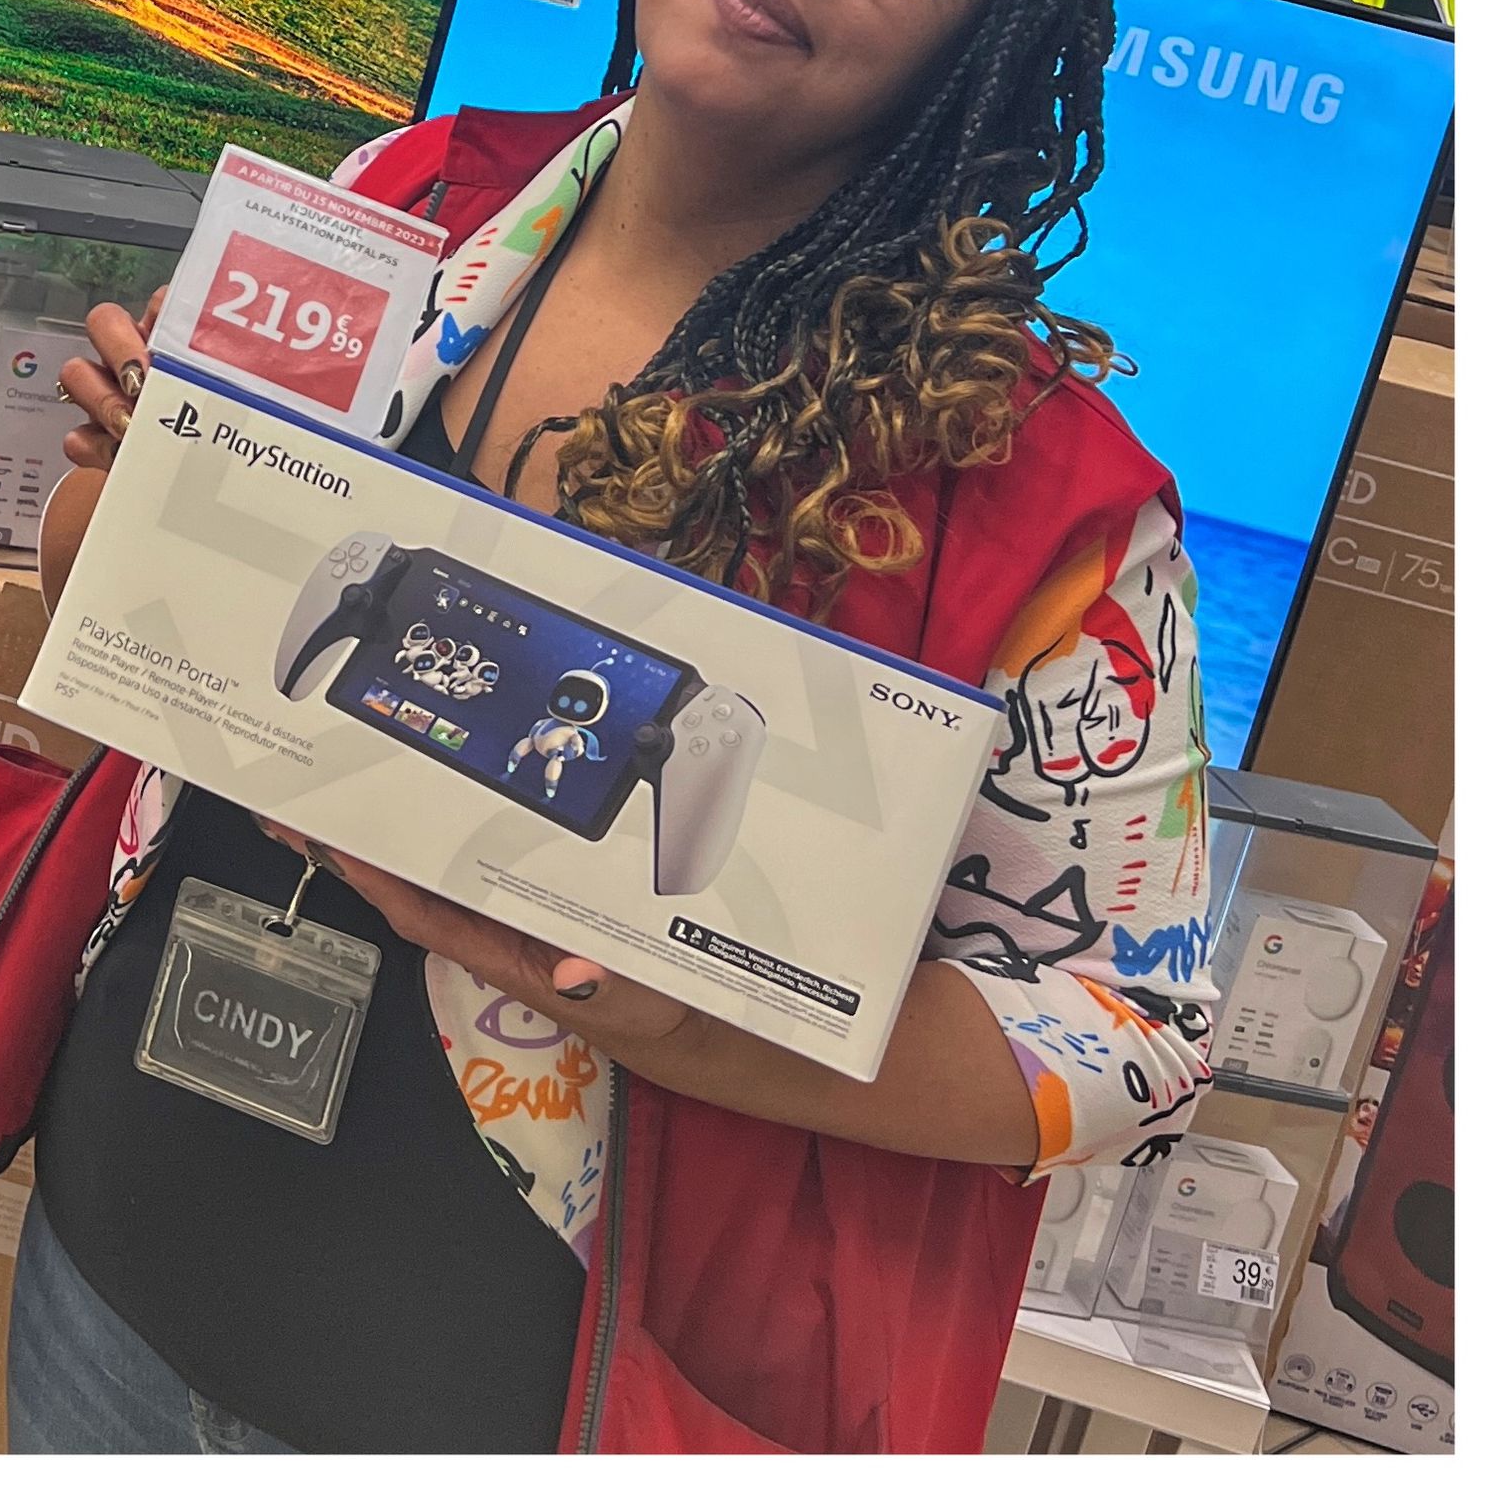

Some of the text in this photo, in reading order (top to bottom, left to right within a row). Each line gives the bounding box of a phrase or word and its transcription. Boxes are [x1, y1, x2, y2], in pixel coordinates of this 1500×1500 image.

[1105, 26, 1345, 125] MSUNG
[237, 164, 426, 247] A PARTIR DU 15 NOVEMBRE 2023
[245, 200, 260, 214] LA
[260, 205, 335, 242] PLAYSTATION
[335, 235, 377, 260] PORTAL
[211, 270, 333, 351] 219
[329, 330, 364, 360] 99
[210, 421, 353, 500] PlayStation
[79, 616, 173, 671] PlayStation
[66, 650, 118, 681] Dispositivo
[118, 675, 141, 691] para
[170, 695, 213, 723] distancia
[221, 718, 278, 750] Reprodutor
[277, 744, 315, 768] remoto
[72, 636, 110, 661] Remote
[110, 653, 141, 675] Player
[227, 705, 264, 730] Lecteur
[272, 726, 314, 751] distance
[868, 682, 963, 731] SONY
[193, 989, 314, 1060] CINDY
[1232, 1258, 1262, 1287] 39
[1261, 1277, 1274, 1291] 99
